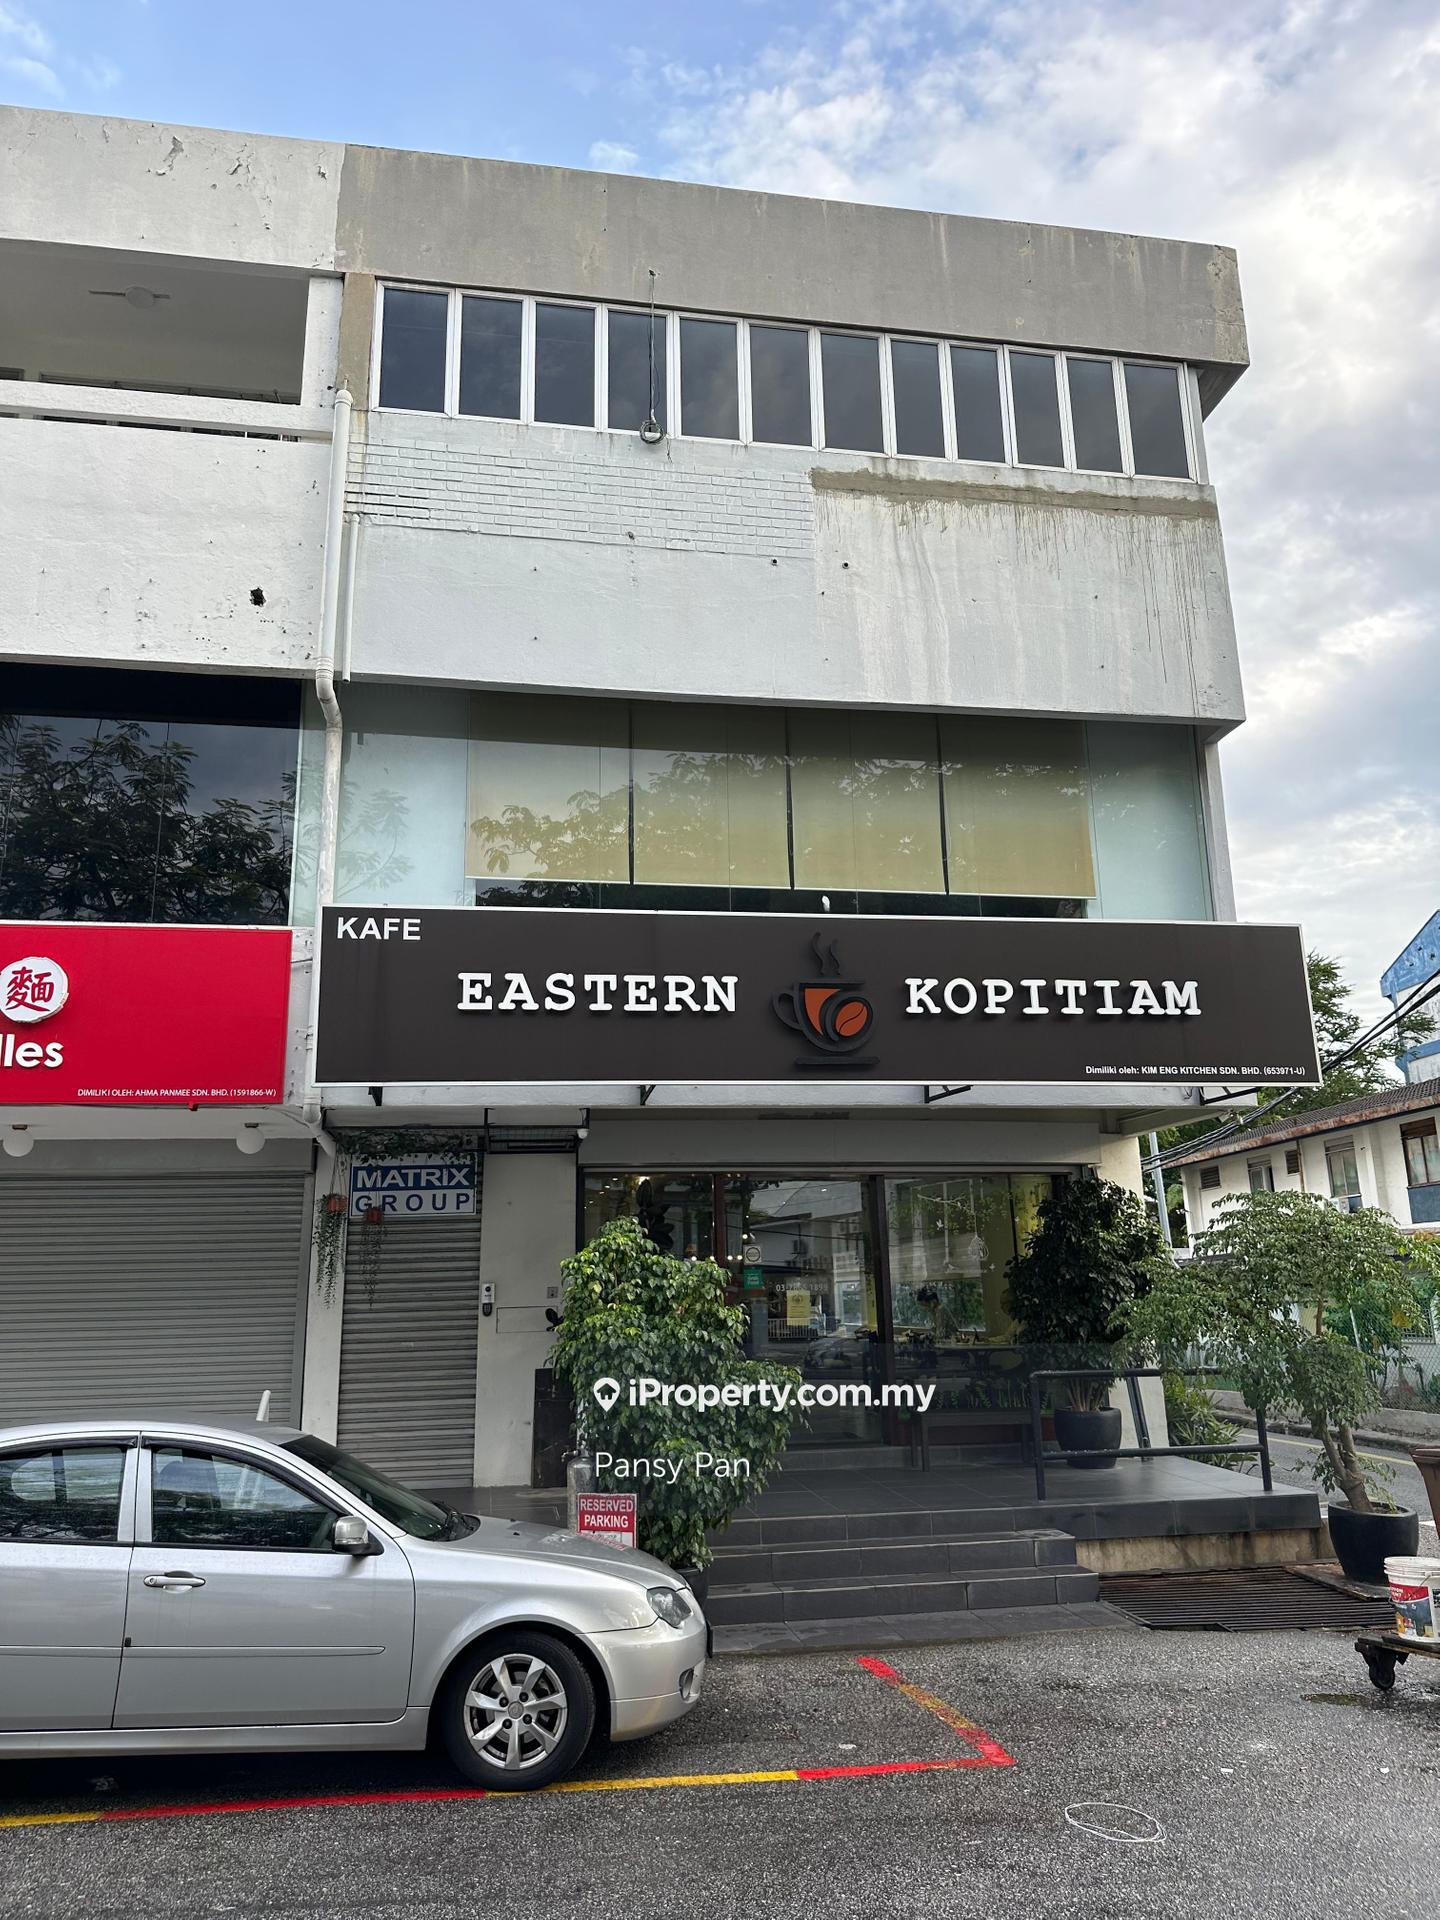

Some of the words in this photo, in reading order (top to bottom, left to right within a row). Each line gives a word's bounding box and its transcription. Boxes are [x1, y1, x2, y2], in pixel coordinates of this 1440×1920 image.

[337, 917, 421, 941] KAFE
[5, 966, 54, 1012] 麵
[457, 972, 739, 1012] EASTERN
[904, 977, 1201, 1016] KOPITIAM
[1085, 1065, 1117, 1074] Dimiliki
[1118, 1065, 1140, 1074] oleh:
[1141, 1066, 1158, 1075] KIM
[1159, 1066, 1178, 1075] ENG
[1180, 1066, 1218, 1075] KITCHEN
[1219, 1066, 1240, 1075] SDN.
[1242, 1066, 1262, 1075] BHD.
[1263, 1066, 1306, 1076] (653971-U)
[77, 1088, 111, 1097] DIMILIKI
[111, 1088, 134, 1097] OLEH:
[135, 1088, 159, 1097] AHMA
[160, 1088, 191, 1097] PANMEE
[191, 1088, 210, 1097] SDN.
[211, 1088, 229, 1097] BHD.
[230, 1088, 277, 1097] (1591866-W)
[356, 1167, 471, 1189] MATRIX
[355, 1192, 471, 1213] GROUP
[580, 1499, 634, 1512] RESERVED
[584, 1514, 629, 1528] PARKING
